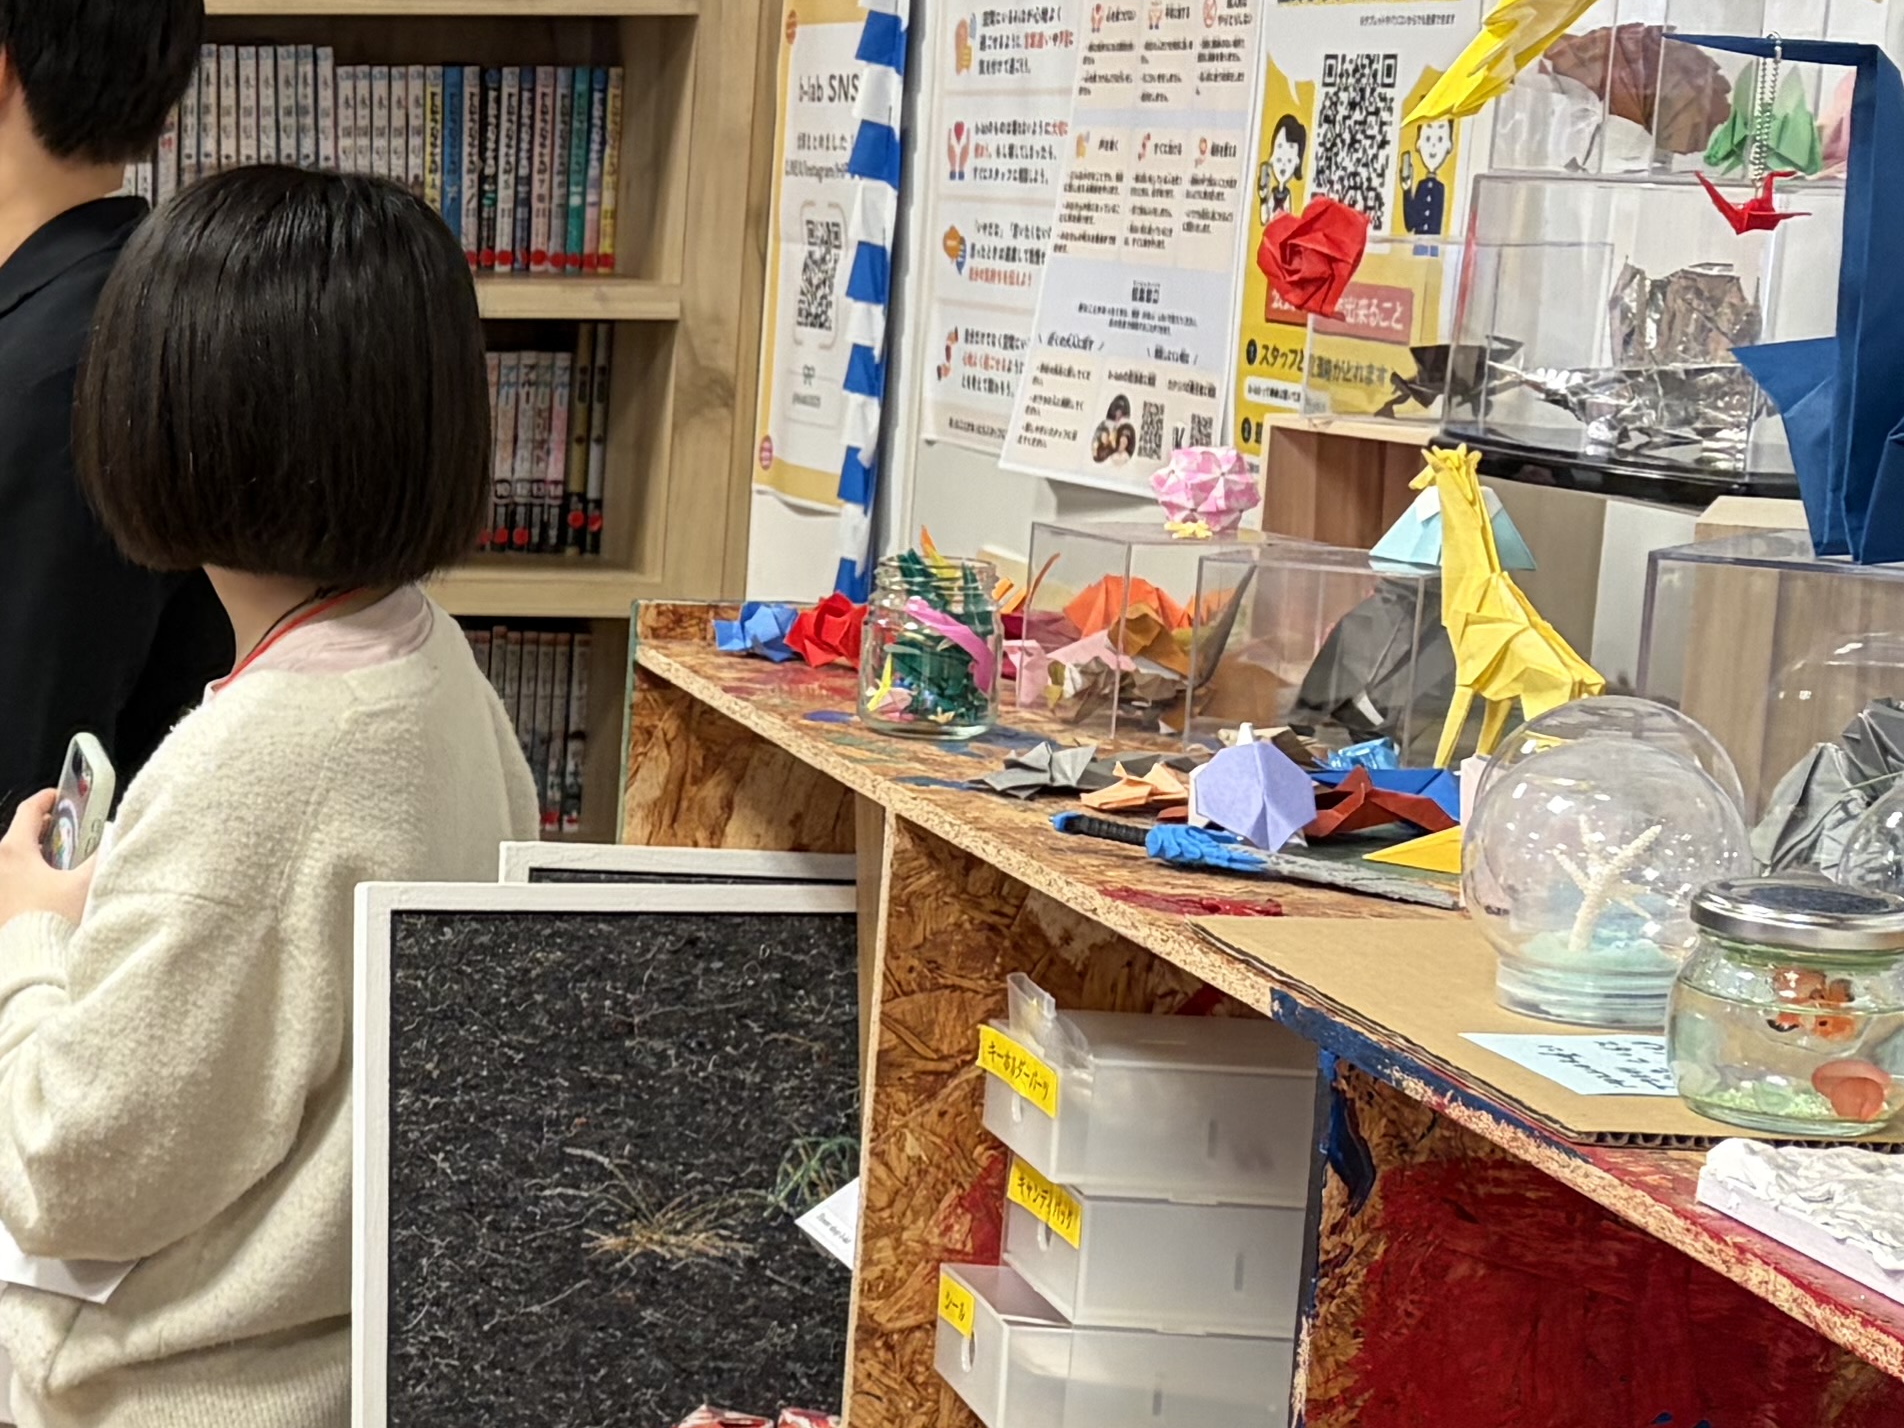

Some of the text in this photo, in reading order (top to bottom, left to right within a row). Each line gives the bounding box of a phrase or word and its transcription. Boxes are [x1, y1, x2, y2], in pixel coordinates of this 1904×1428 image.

[799, 73, 860, 103] b-lab SNS
[944, 1290, 966, 1322] シール
